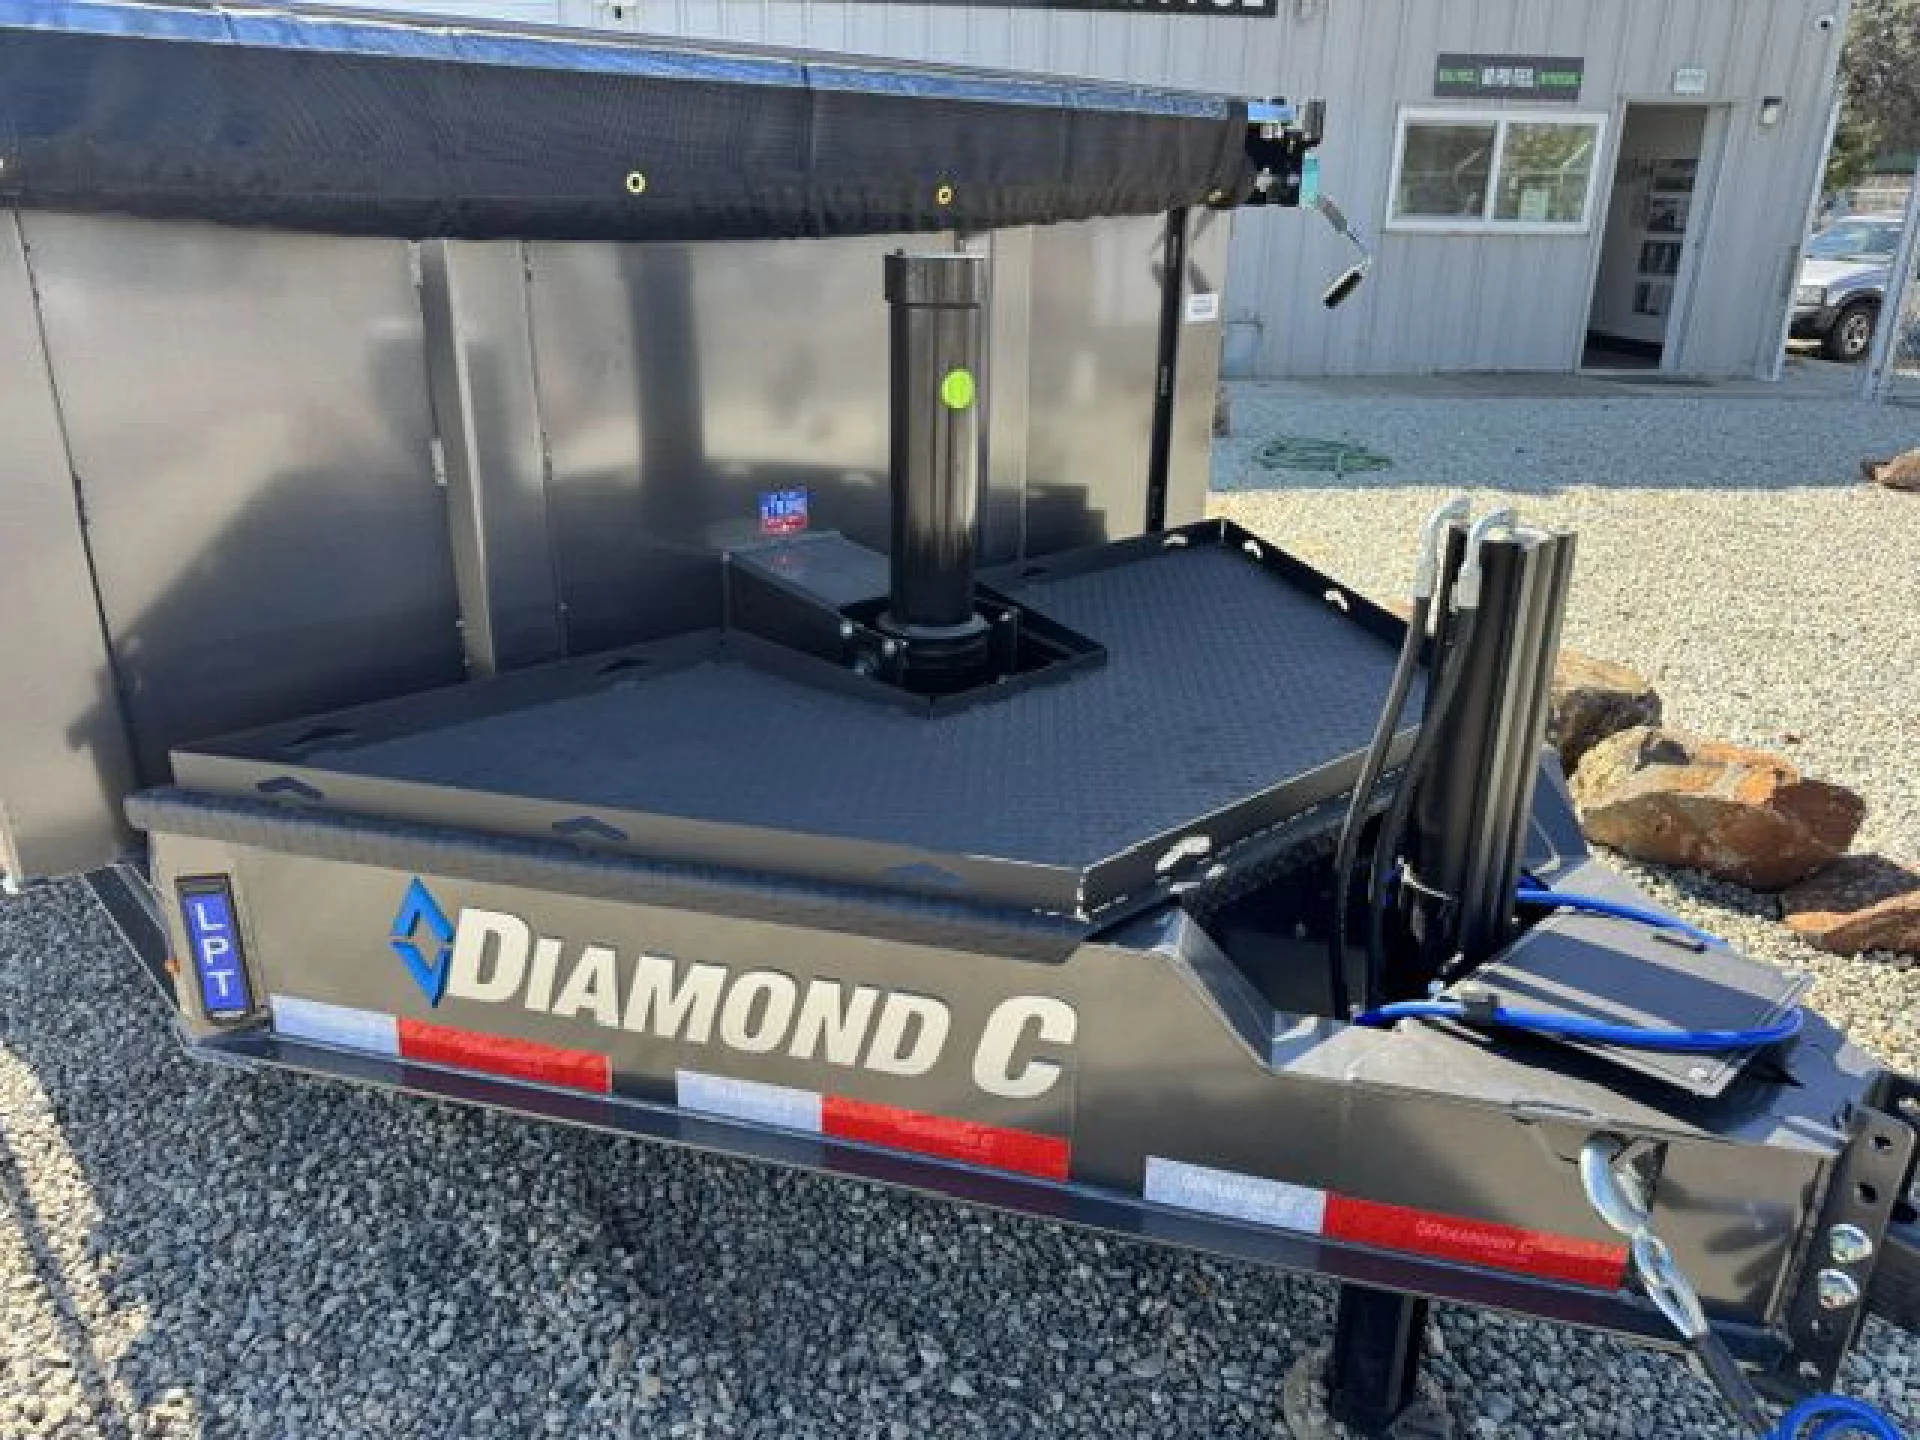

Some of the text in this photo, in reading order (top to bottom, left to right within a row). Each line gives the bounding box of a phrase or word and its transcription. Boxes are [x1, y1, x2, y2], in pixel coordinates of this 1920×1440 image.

[194, 902, 235, 997] LPT
[447, 907, 1077, 1099] DIAMOND C
